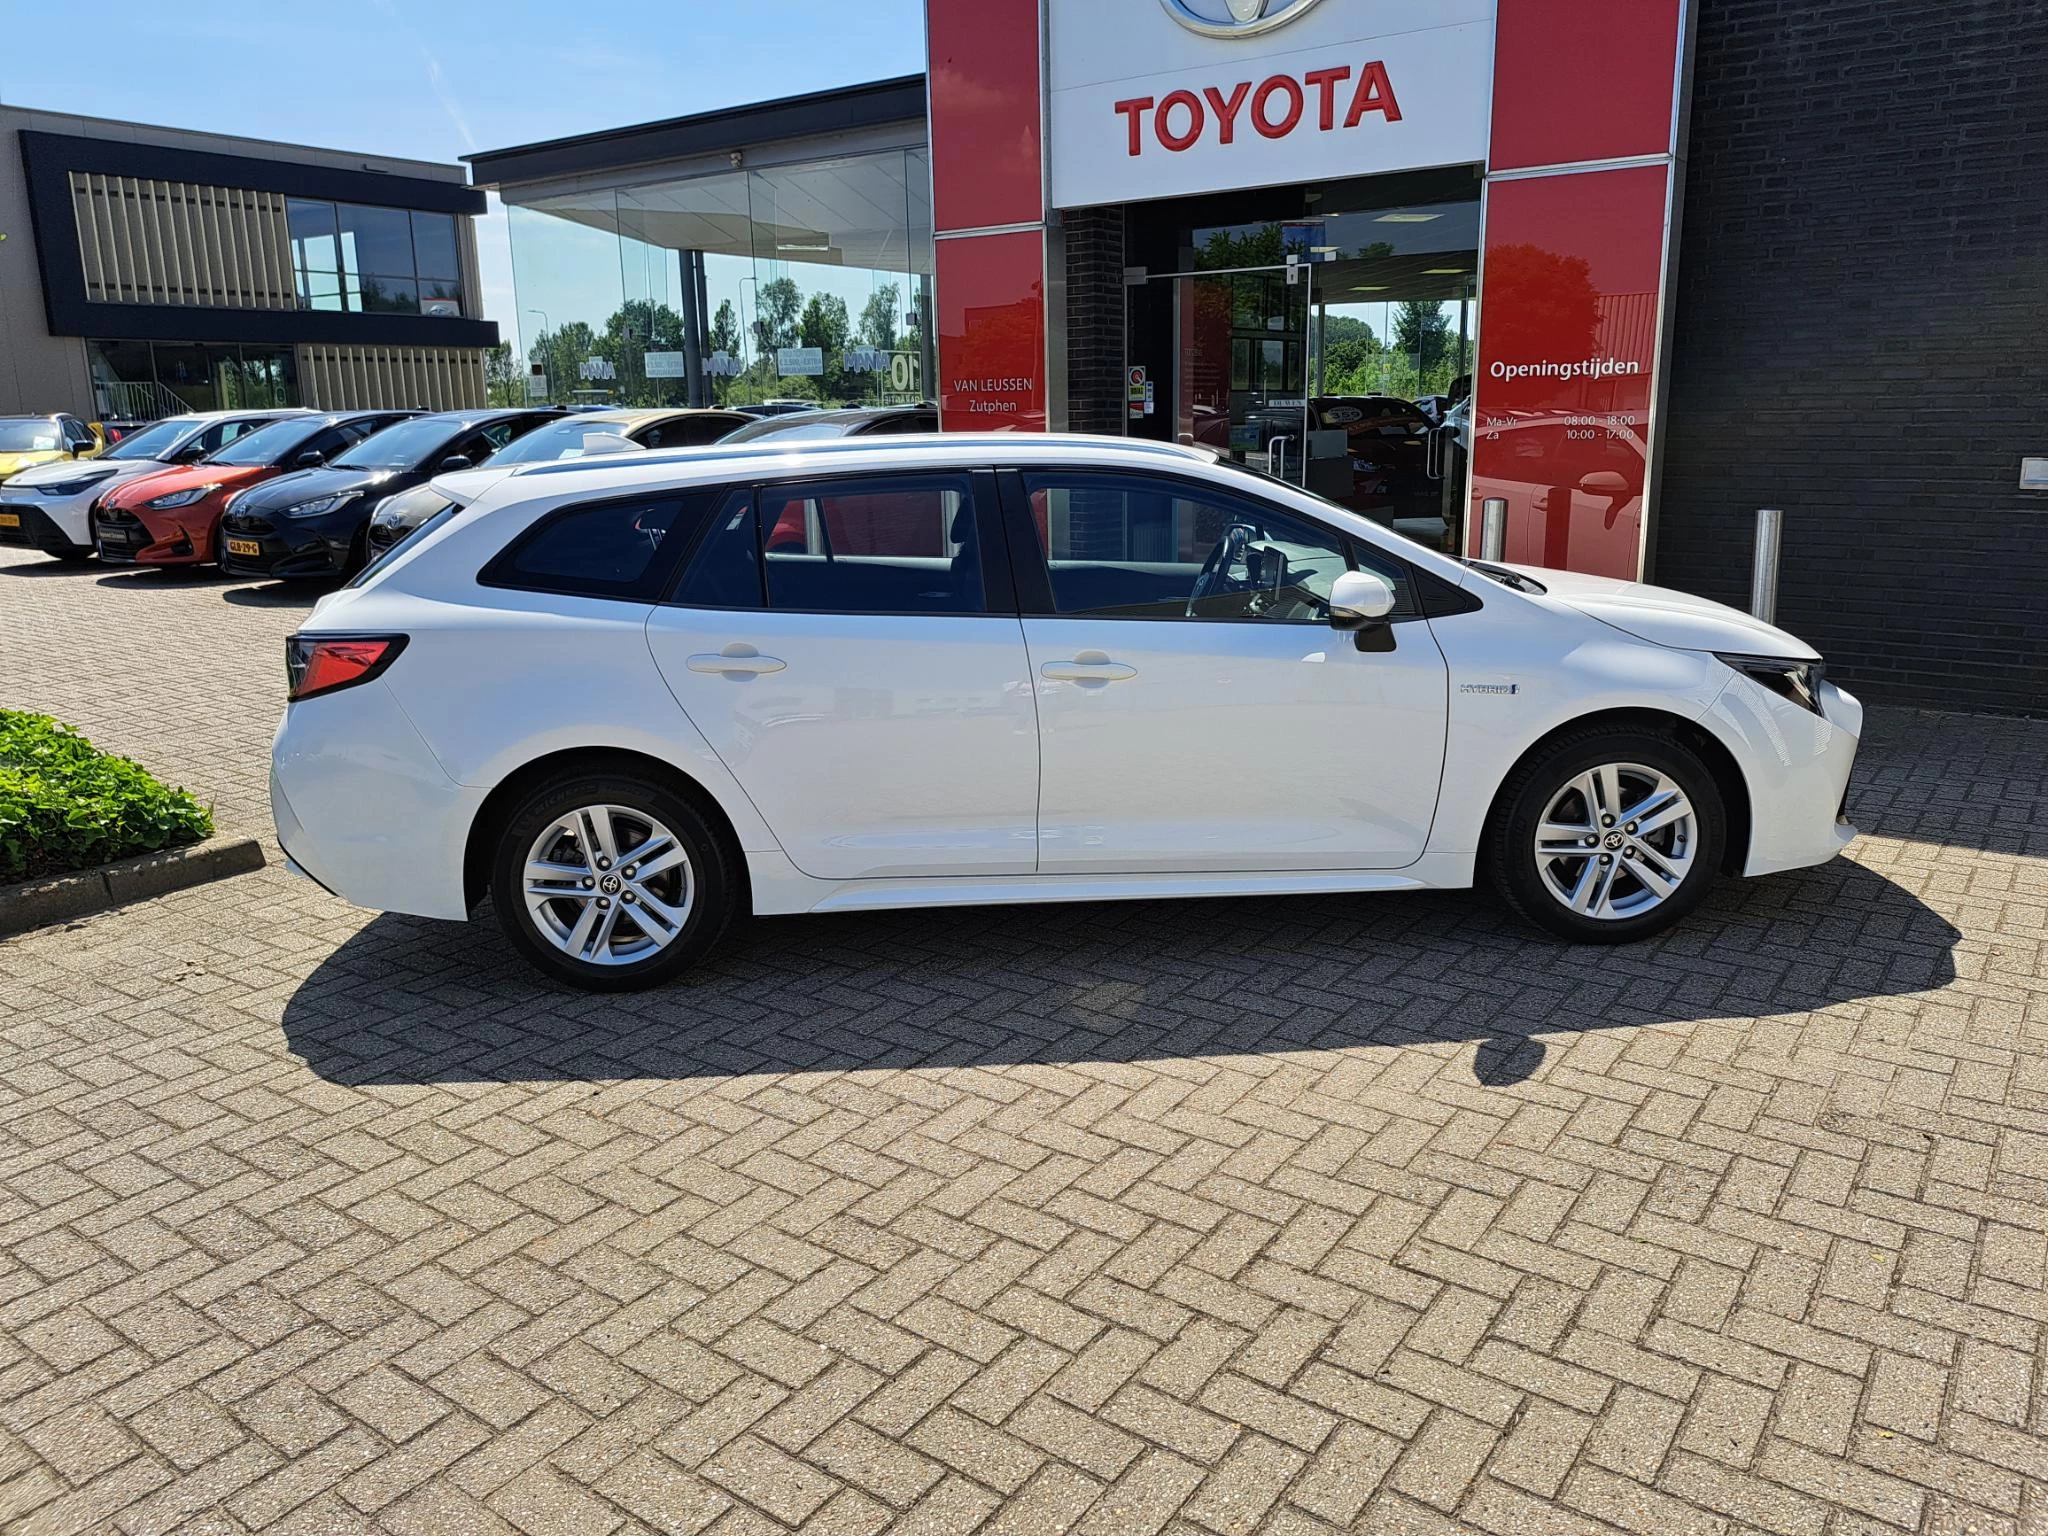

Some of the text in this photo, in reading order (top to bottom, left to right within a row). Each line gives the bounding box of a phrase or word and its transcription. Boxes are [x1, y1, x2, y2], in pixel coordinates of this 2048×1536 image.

[1115, 60, 1403, 157] TOYOTA
[1490, 358, 1639, 381] Openingstijden
[953, 377, 1033, 392] VAN LEUSSEN
[969, 399, 1017, 414] Zutphen
[1486, 415, 1518, 427] Ma-Vr
[1564, 415, 1596, 426] 08:00
[1606, 415, 1636, 426] 18:00
[1486, 430, 1500, 440] Za
[1566, 429, 1595, 440] 10:00
[1606, 429, 1634, 440] 17:00
[1460, 684, 1509, 694] HYBRID
